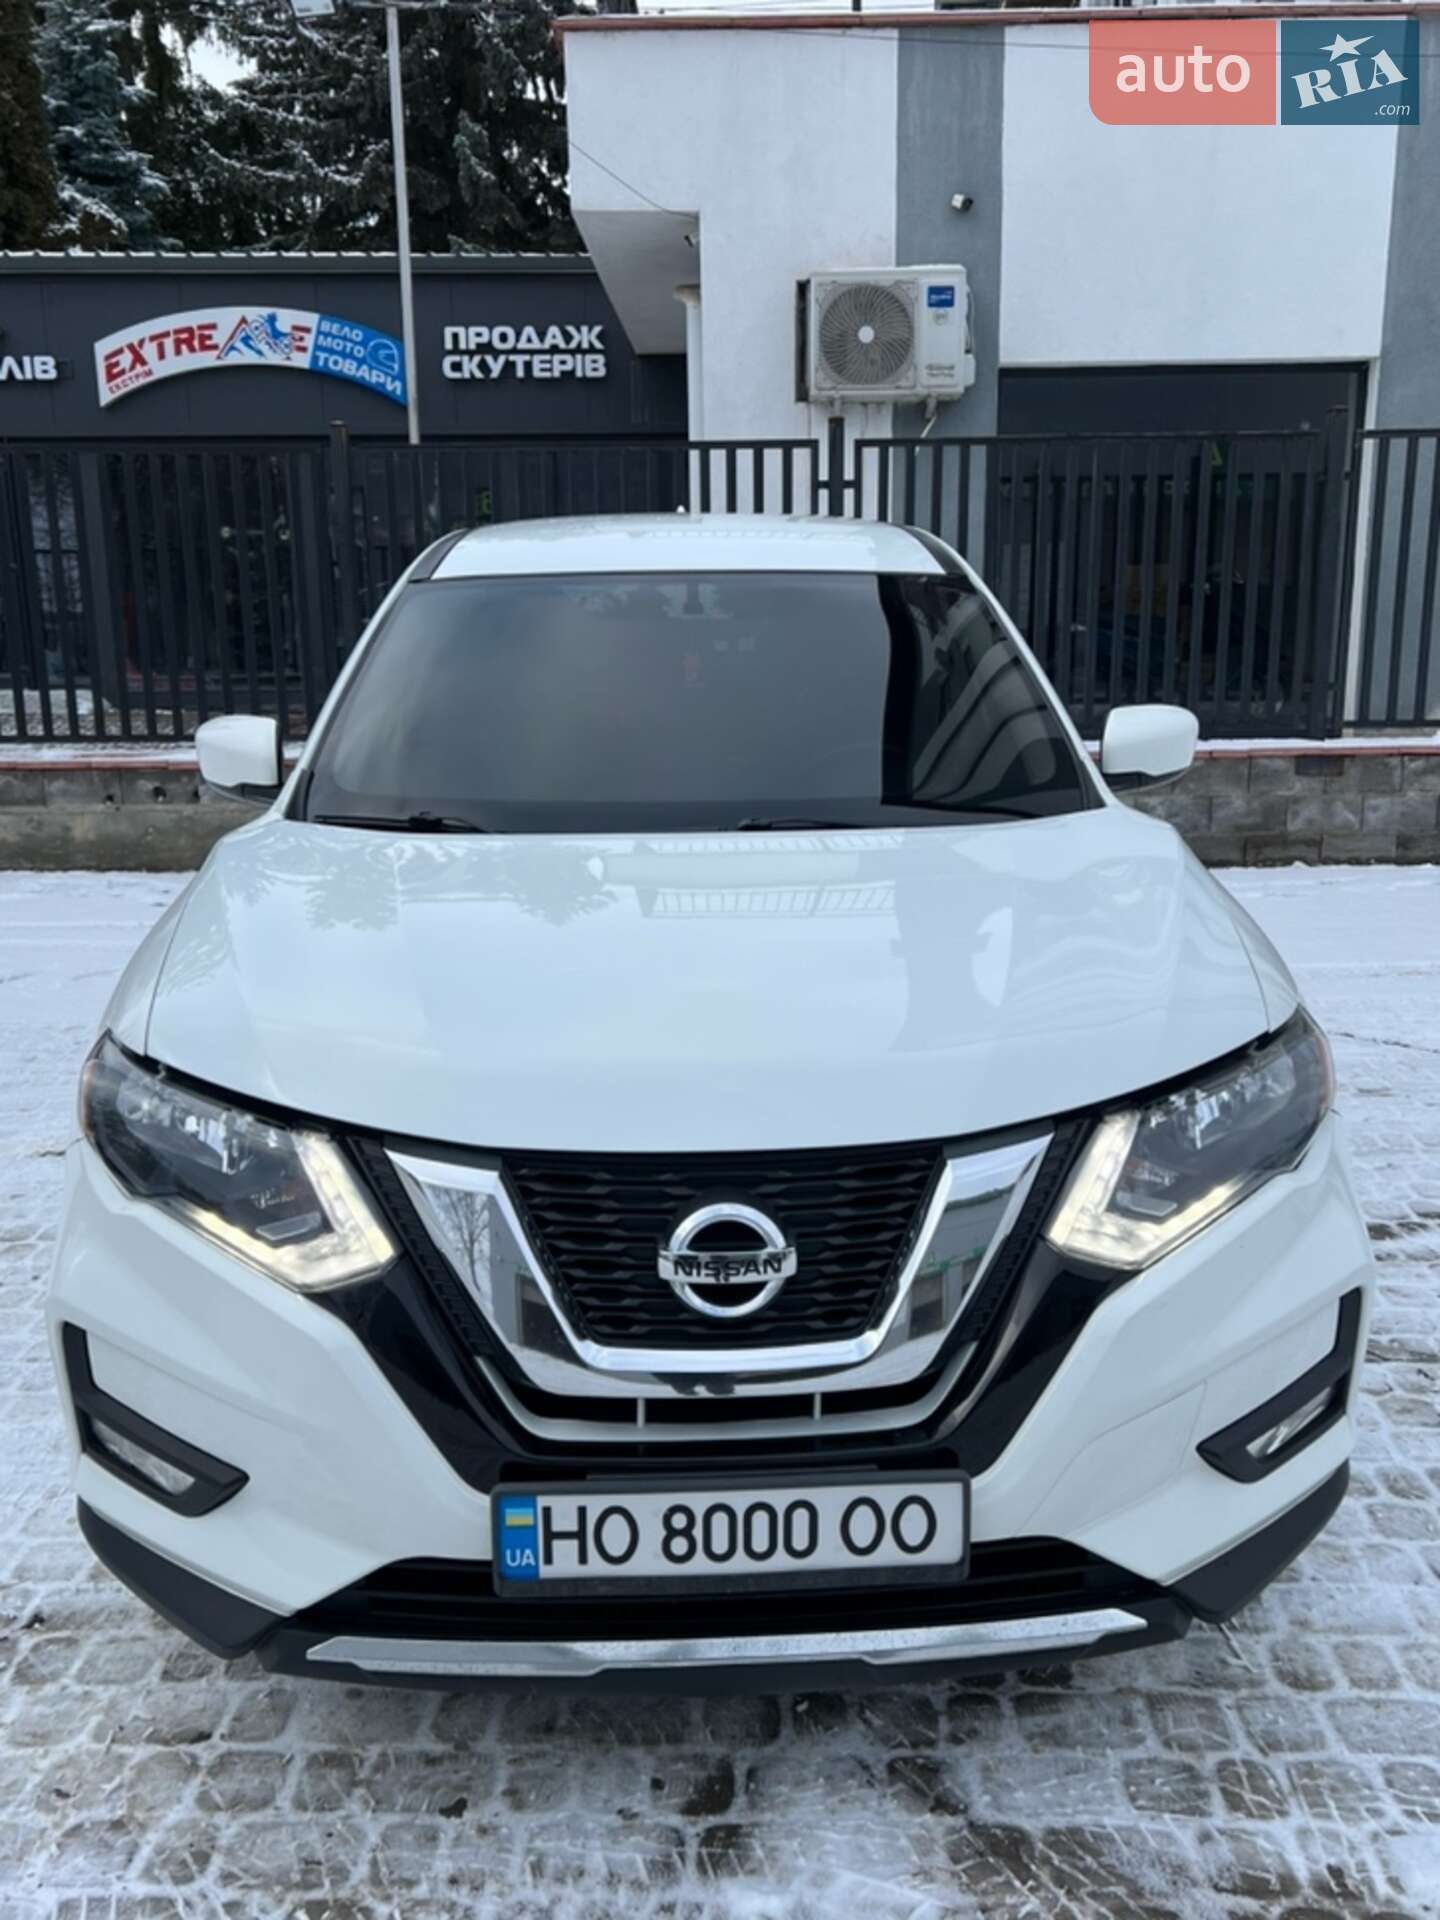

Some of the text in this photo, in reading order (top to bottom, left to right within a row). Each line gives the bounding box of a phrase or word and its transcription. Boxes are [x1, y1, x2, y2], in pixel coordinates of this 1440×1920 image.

[320, 320, 363, 343] ВЕЛО
[444, 325, 605, 350] ПРОДАЖ
[317, 335, 365, 358] МОТО
[315, 351, 402, 396] ТОВАРИ
[442, 354, 607, 379] СКУТЕРІВ
[673, 1258, 783, 1277] NISSAN
[542, 1505, 640, 1566] HO
[660, 1499, 819, 1564] 8000
[505, 1548, 536, 1568] UA
